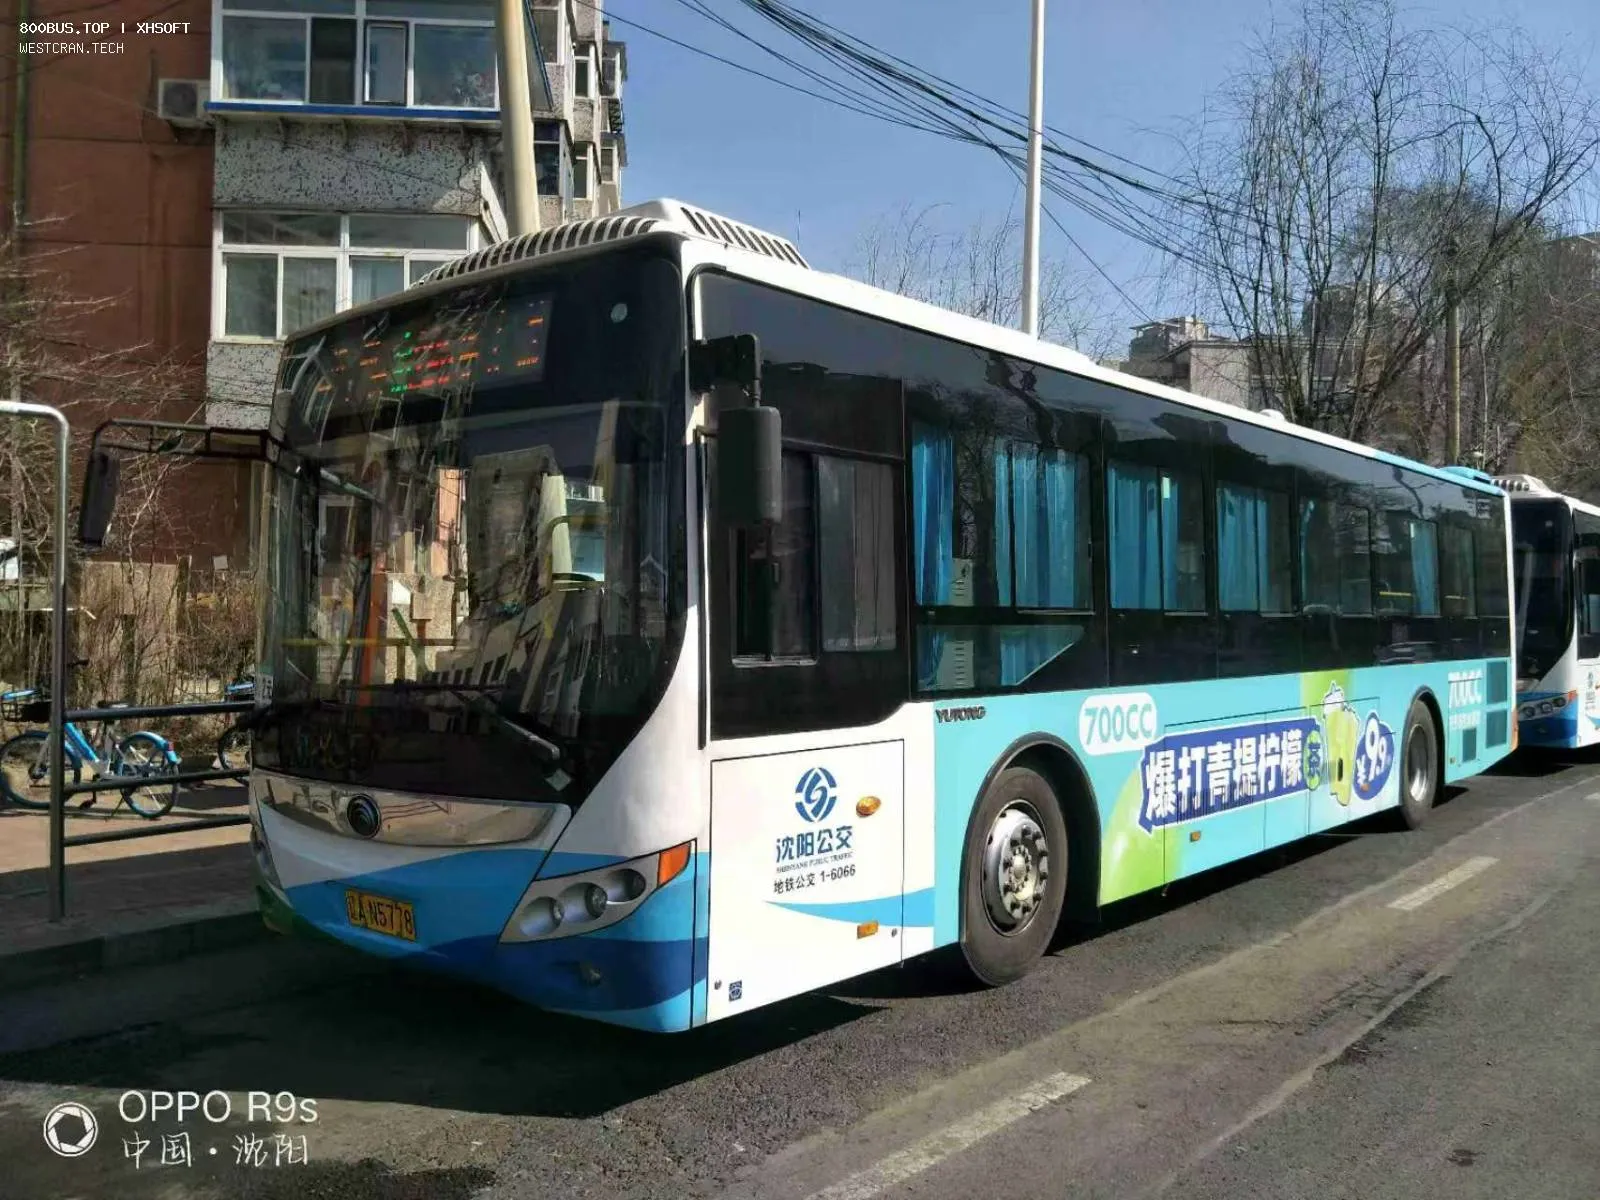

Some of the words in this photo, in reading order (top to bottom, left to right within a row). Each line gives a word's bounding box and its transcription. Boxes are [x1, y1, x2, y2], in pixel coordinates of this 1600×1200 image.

[935, 706, 986, 723] YUTONG
[1083, 703, 1153, 745] 700CC
[776, 825, 853, 863] 沈阳公交
[774, 873, 815, 894] 地铁公交
[820, 864, 856, 882] 1-6066
